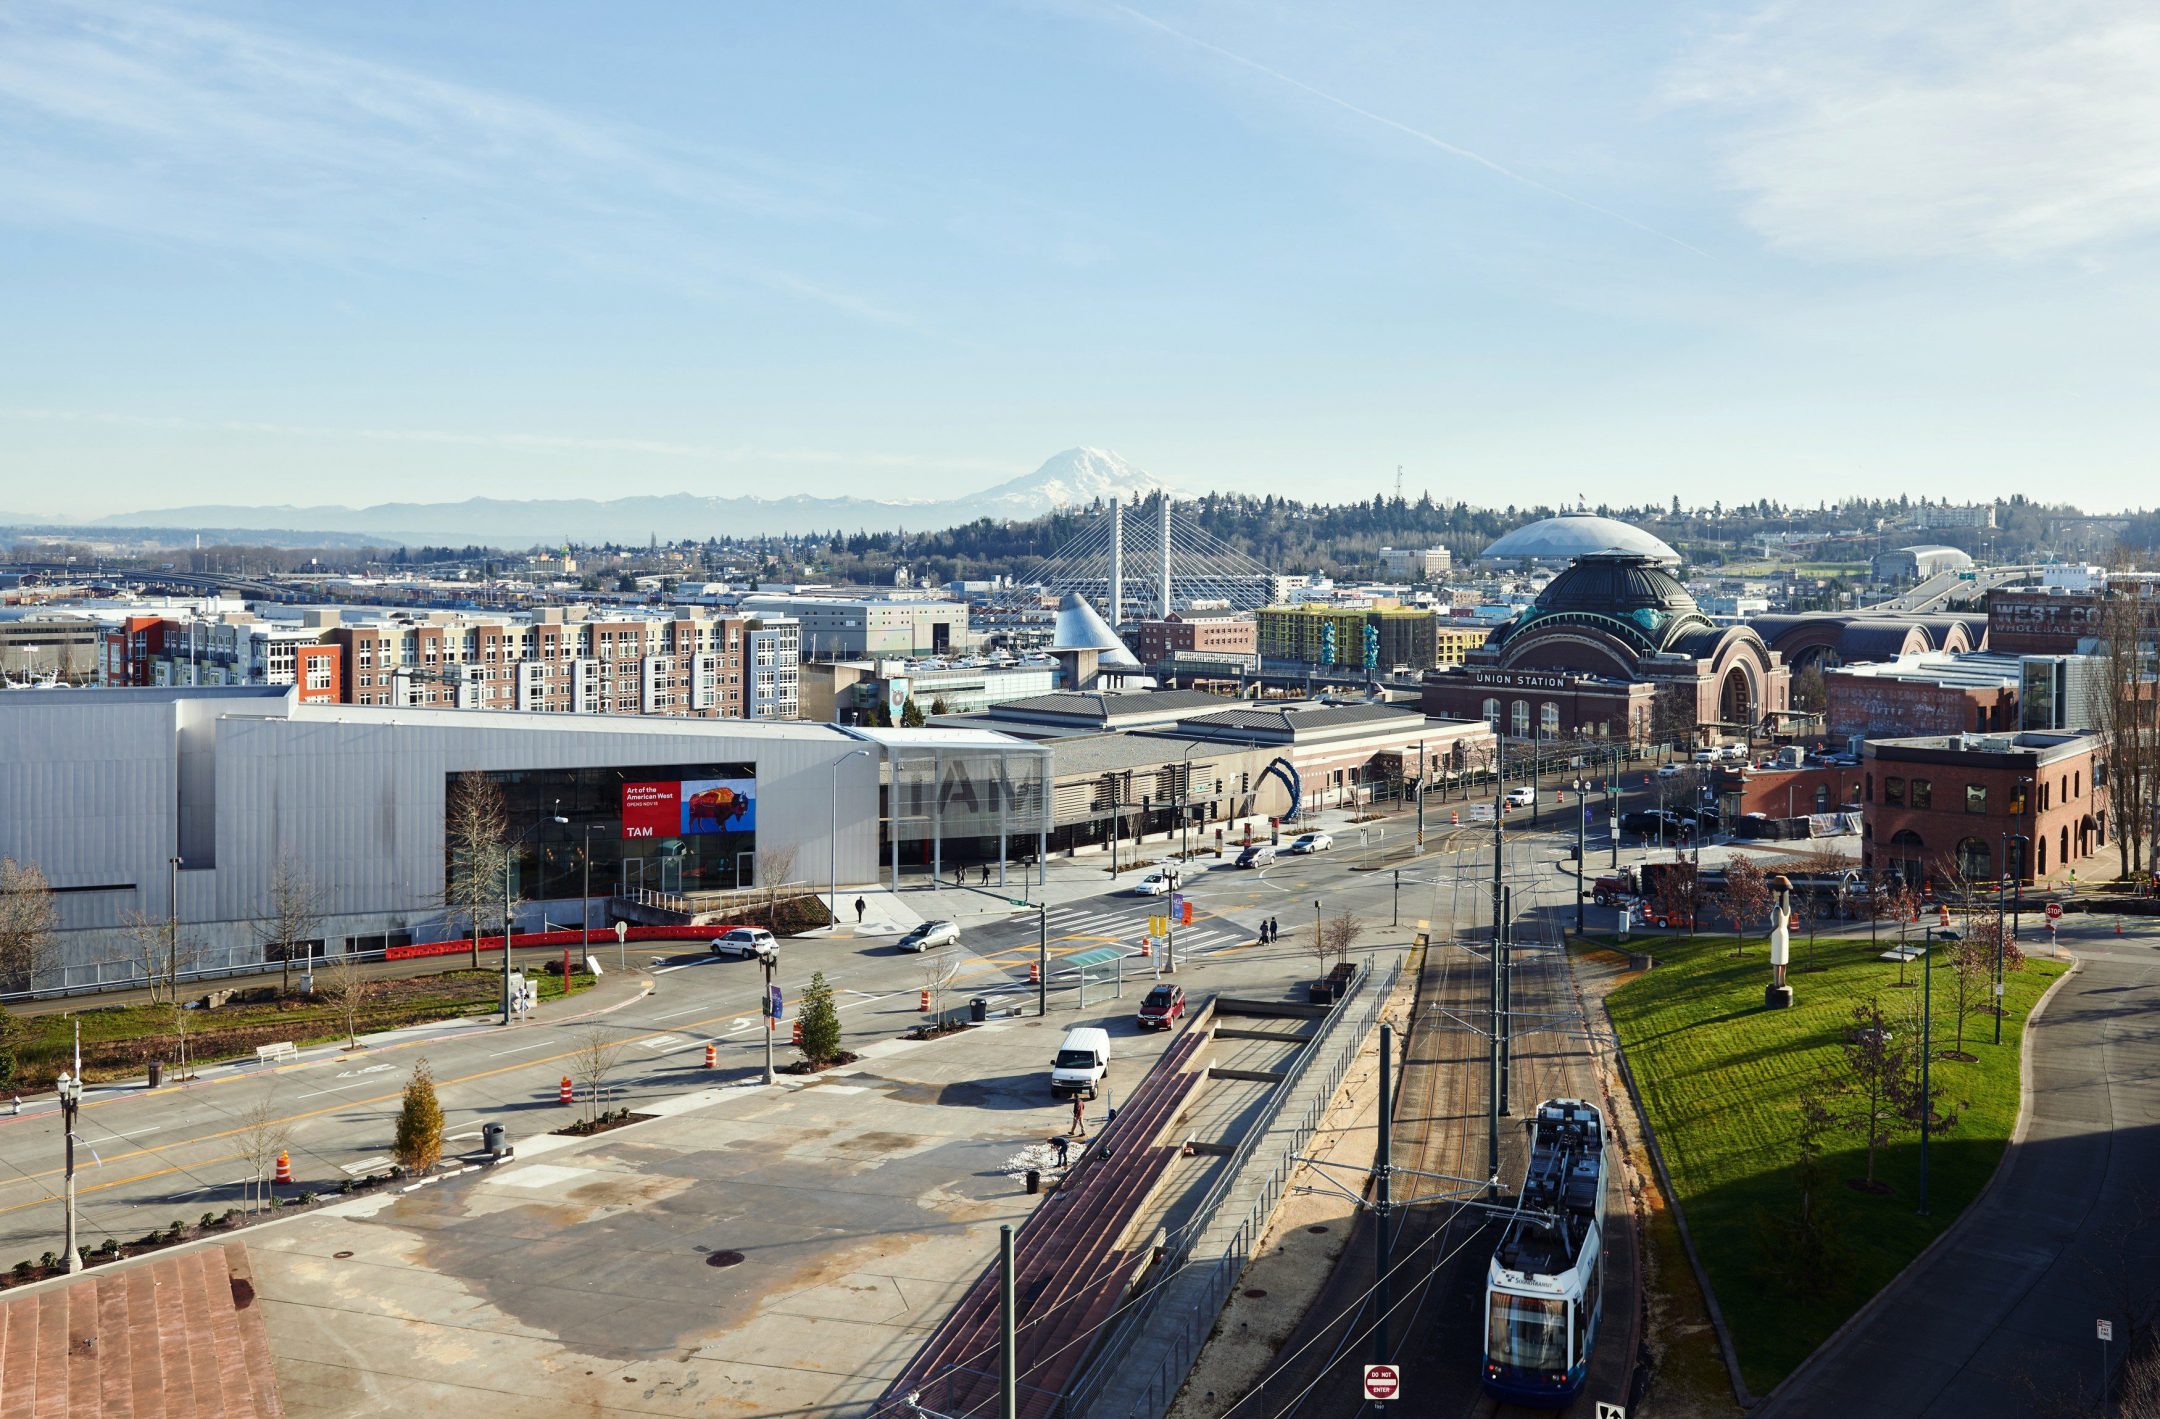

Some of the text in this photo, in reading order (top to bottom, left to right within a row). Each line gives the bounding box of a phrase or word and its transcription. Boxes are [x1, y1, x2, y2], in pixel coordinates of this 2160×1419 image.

[1996, 605, 2060, 624] WEST
[1995, 624, 2079, 634] WHOLESALE
[1476, 674, 1564, 687] UNION STATION
[900, 759, 1042, 816] TAM
[627, 827, 653, 836] TAM
